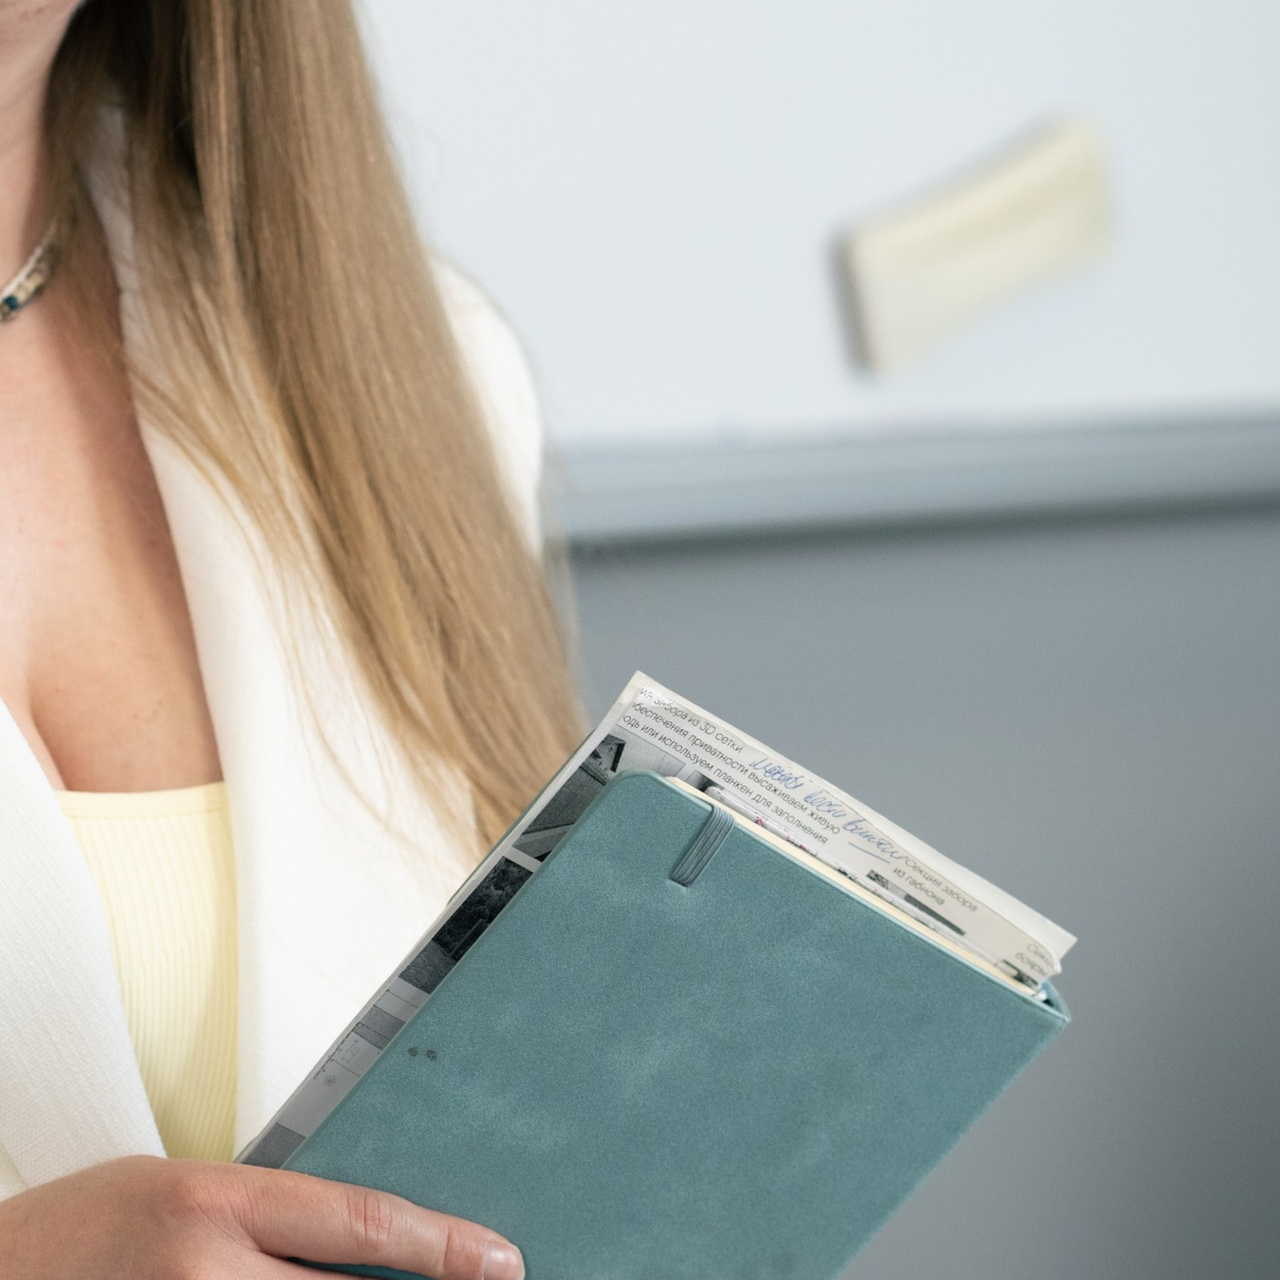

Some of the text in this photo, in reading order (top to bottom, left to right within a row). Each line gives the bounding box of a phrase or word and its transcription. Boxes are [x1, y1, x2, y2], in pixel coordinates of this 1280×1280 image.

[688, 717, 700, 726] из
[700, 722, 716, 735] 3D
[715, 733, 743, 753] сетки
[641, 725, 659, 738] или
[658, 735, 714, 771] используем
[713, 768, 753, 796] планкен
[752, 794, 772, 808] для
[772, 806, 828, 844] заполнения
[688, 735, 748, 774] приватности
[748, 772, 807, 812] высаживаем
[808, 811, 840, 834] живую
[893, 868, 945, 905] из габиона
[905, 857, 977, 911] Секция забора
